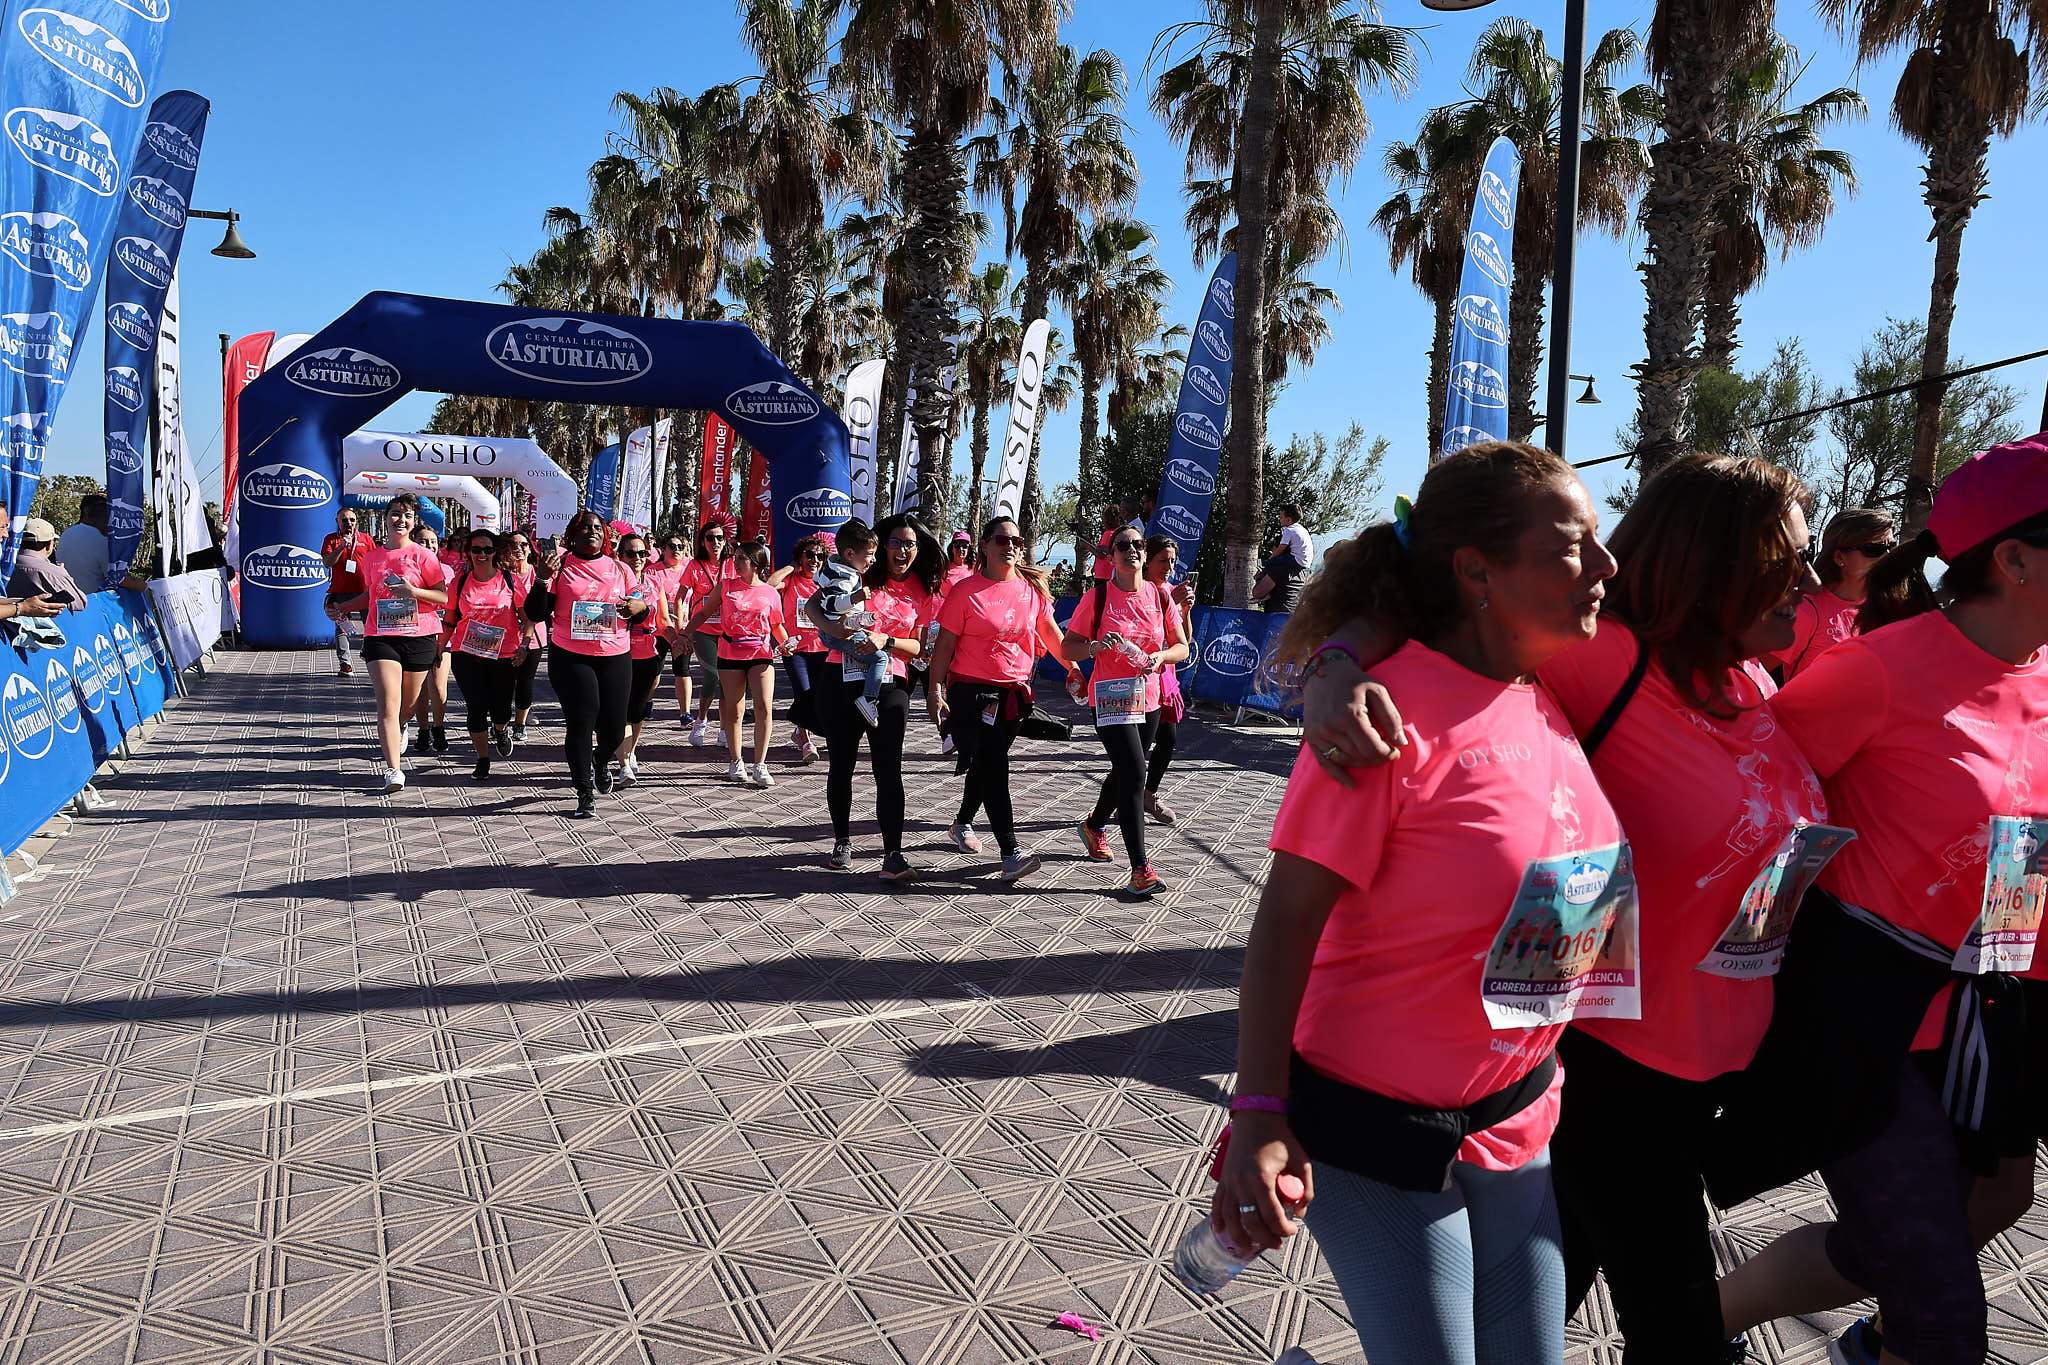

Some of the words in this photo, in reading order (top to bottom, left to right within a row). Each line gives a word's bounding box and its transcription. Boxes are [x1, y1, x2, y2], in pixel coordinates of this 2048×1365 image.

[56, 26, 102, 55] CENTRAL
[29, 18, 137, 103] ASTURIANA
[36, 124, 89, 150] CENTRAL
[498, 332, 641, 372] ASTURIANA
[525, 333, 579, 345] CENTRAL
[583, 338, 635, 350] LECHERA
[292, 362, 392, 387] ASTURIANA
[311, 361, 350, 369] CENTRAL
[733, 396, 815, 414] ASTURIANA
[383, 440, 497, 466] OYSHO
[712, 422, 727, 492] Santander
[527, 469, 559, 478] OYSHO
[1169, 463, 1211, 492] ASTURIANA
[246, 479, 328, 500] ASTURIANA
[544, 512, 573, 521] OYSHO
[246, 559, 327, 579] ASTURIANA
[8, 706, 52, 744] ASTURIANA
[1459, 743, 1532, 769] OYSHO
[1721, 959, 1764, 970] OYSHO
[1490, 981, 1532, 994] CARRERA
[1534, 983, 1547, 993] DE
[1547, 982, 1559, 993] LA
[1498, 1000, 1545, 1016] OYSHO
[1567, 995, 1616, 1009] Santander
